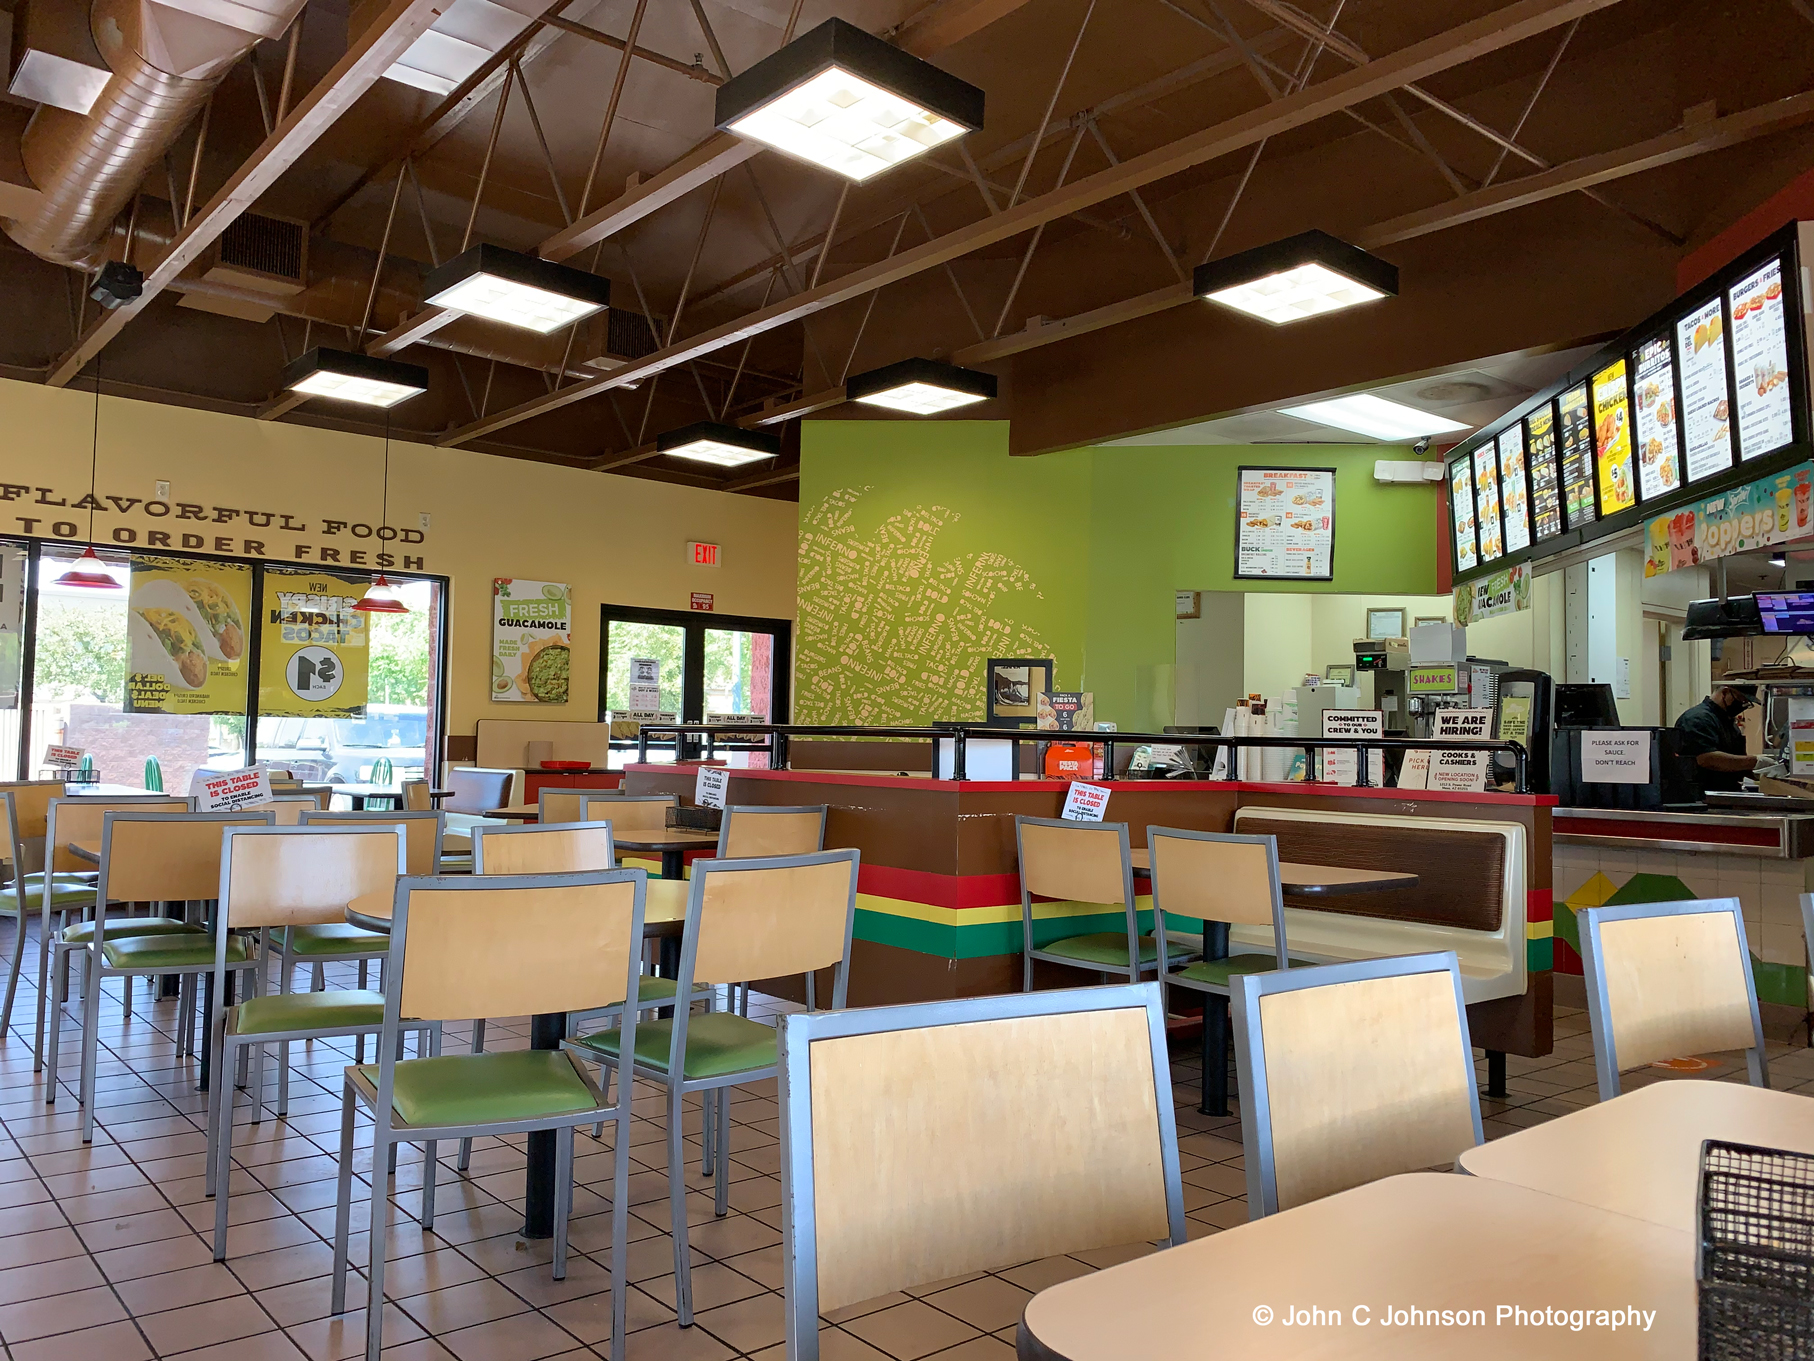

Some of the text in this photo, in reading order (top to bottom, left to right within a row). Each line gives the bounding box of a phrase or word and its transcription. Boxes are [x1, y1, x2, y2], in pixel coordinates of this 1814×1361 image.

[1733, 265, 1780, 301] BURGERS FRIES
[1684, 304, 1720, 332] TACOS MORE
[1644, 342, 1661, 361] EPIC
[1638, 348, 1670, 372] BURRITOS
[1598, 375, 1626, 402] CRISPY
[1598, 390, 1628, 414] CHICKEN
[1616, 412, 1623, 422] $4
[1611, 468, 1618, 479] $5
[830, 498, 846, 507] TACOS
[1707, 498, 1725, 514] NEW
[0, 483, 424, 544] FLAVORFUL FOOD
[832, 525, 855, 536] BEANS
[16, 517, 424, 570] TO ORDER FRESH
[816, 533, 858, 559] INFERNO
[695, 544, 717, 564] EXIT
[926, 588, 948, 603] BOLD
[510, 603, 560, 617] FRESH
[839, 593, 852, 614] TACOS
[872, 608, 895, 621] TACOS
[498, 618, 567, 630] GUACAMOLE
[988, 619, 1011, 634] BOLD
[918, 613, 945, 655] INFERNO
[862, 640, 874, 663] BEANS
[818, 665, 842, 677] BEANS
[840, 656, 882, 681] INFERNO
[926, 660, 948, 673] TACOS
[884, 666, 906, 684] BOLD
[921, 672, 944, 686] BOLD
[1413, 674, 1452, 684] SHAKES
[912, 680, 926, 689] FRIES
[1441, 716, 1486, 724] WE ARE
[1440, 727, 1482, 735] HIRING!
[206, 772, 259, 790] THIS TABLE
[222, 781, 259, 794] CLOSED
[230, 791, 251, 799] ENABLE
[232, 793, 264, 804] DISTANCING
[1088, 792, 1104, 800] TABLE
[1080, 799, 1100, 808] CLOSED
